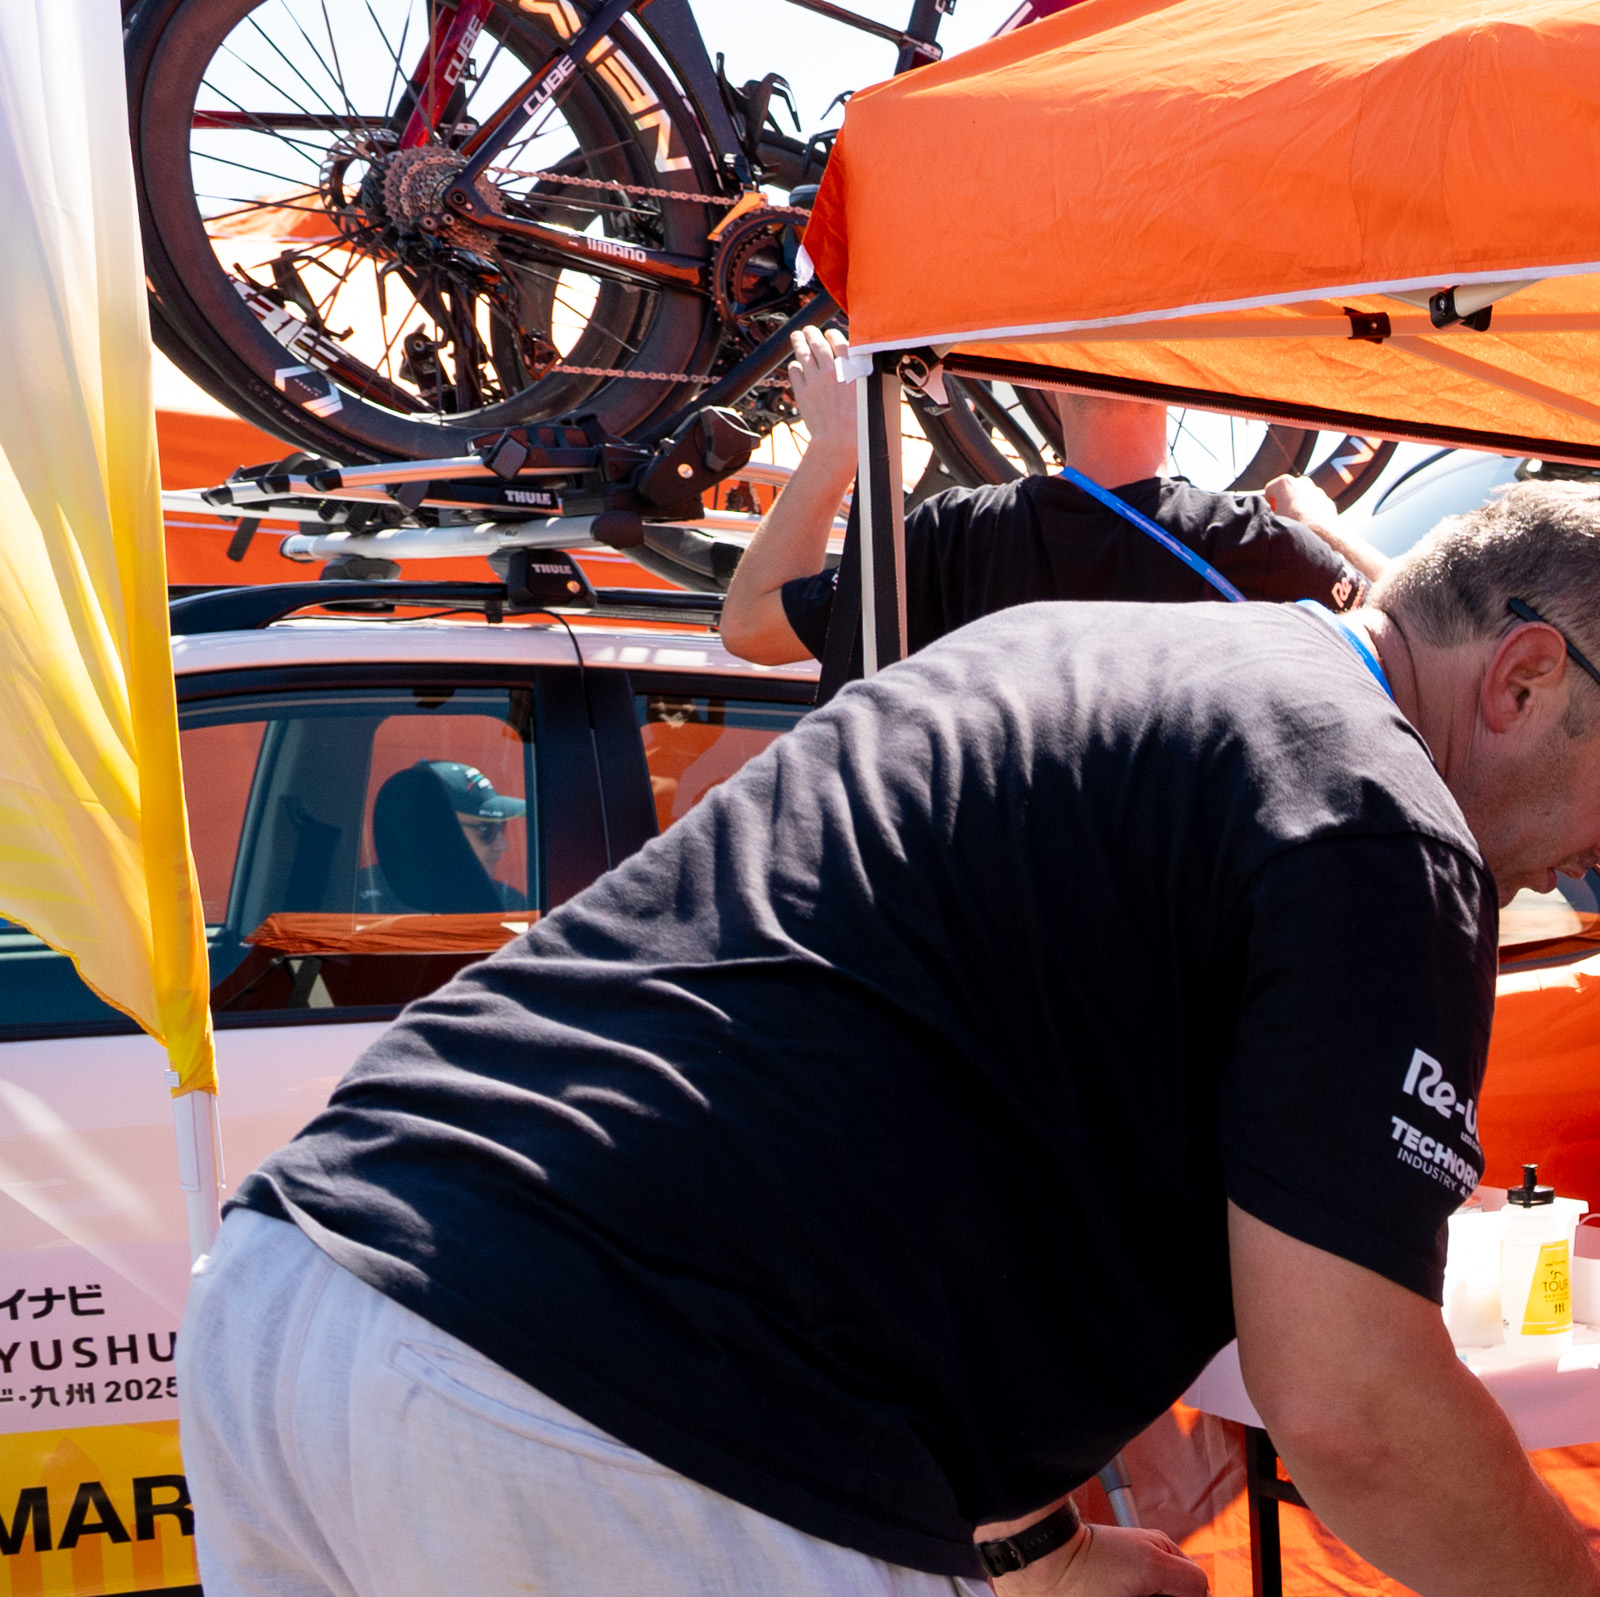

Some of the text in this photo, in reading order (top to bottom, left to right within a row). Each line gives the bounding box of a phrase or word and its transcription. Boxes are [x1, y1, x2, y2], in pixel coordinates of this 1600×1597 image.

[444, 14, 483, 86] CUBE
[522, 55, 576, 116] CUBE
[504, 490, 552, 505] THULE
[531, 563, 573, 575] THULE
[1391, 1115, 1479, 1191] TECHNORD
[1397, 1148, 1457, 1192] INDUSTRY
